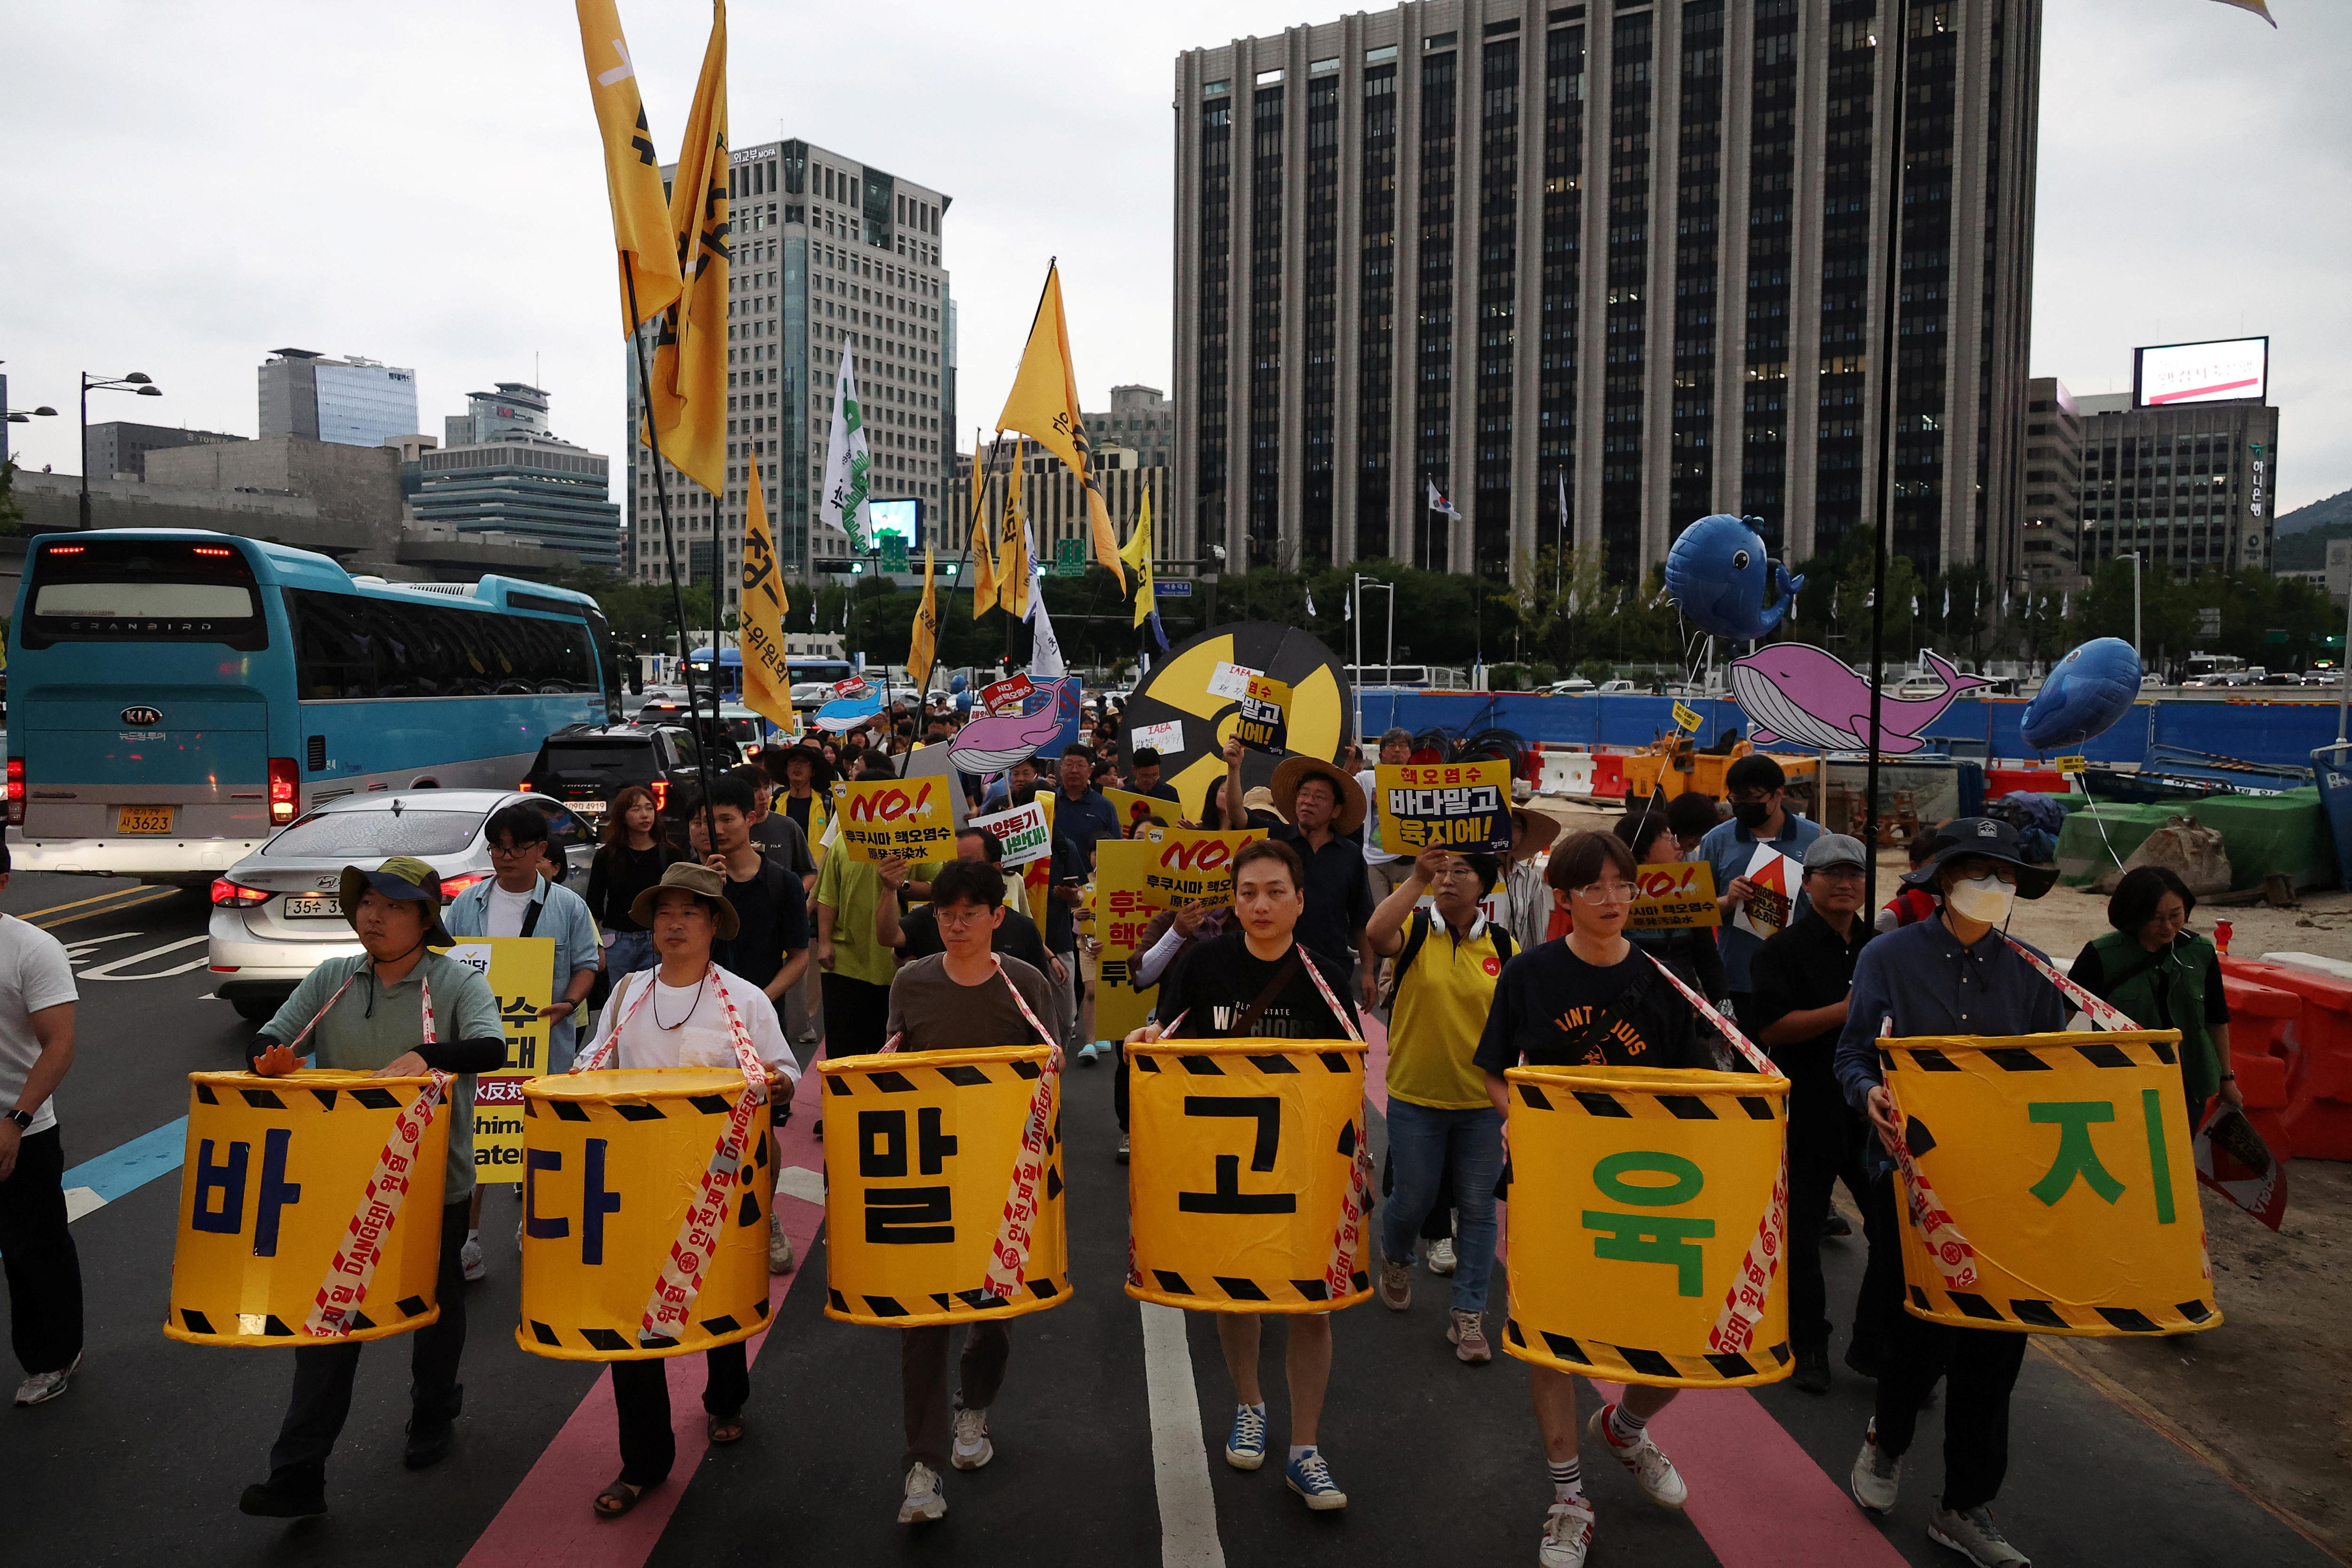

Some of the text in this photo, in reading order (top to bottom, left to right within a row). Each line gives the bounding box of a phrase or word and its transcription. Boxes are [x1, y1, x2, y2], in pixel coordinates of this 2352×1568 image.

[734, 148, 776, 163] 외교부 MOFA
[2251, 460, 2264, 517] 하나은행
[996, 683, 1014, 692] NO!
[1229, 666, 1251, 677] IAEA
[126, 711, 156, 722] KIA
[1147, 723, 1172, 735] IAEA
[1401, 767, 1482, 785] 핵오염수
[850, 782, 932, 823] NO!
[1389, 785, 1498, 816] 바다말고
[122, 817, 168, 829] 사 3623
[845, 827, 951, 845] 후쿠시마 핵오염수
[1400, 815, 1493, 846] 육지에!
[1160, 835, 1253, 874] NO!
[1491, 840, 1510, 848] 정의당
[1146, 875, 1234, 894] 후쿠시마 핵오
[294, 900, 343, 914] 35수 3
[1629, 901, 1715, 915] 시마 핵오염수
[1179, 1096, 1296, 1214] 고
[2028, 1088, 2176, 1225] 지
[380, 1154, 409, 1193] 위험
[858, 1107, 958, 1244] 말
[192, 1128, 302, 1257] 바
[525, 1138, 621, 1265] 다
[1008, 1162, 1037, 1242] 안전제일
[1343, 1203, 1359, 1242] 위험
[1582, 1151, 1715, 1297] 육
[657, 1285, 686, 1323] 위험
[689, 1168, 732, 1248] 안전제일
[1739, 1265, 1766, 1307] 위험
